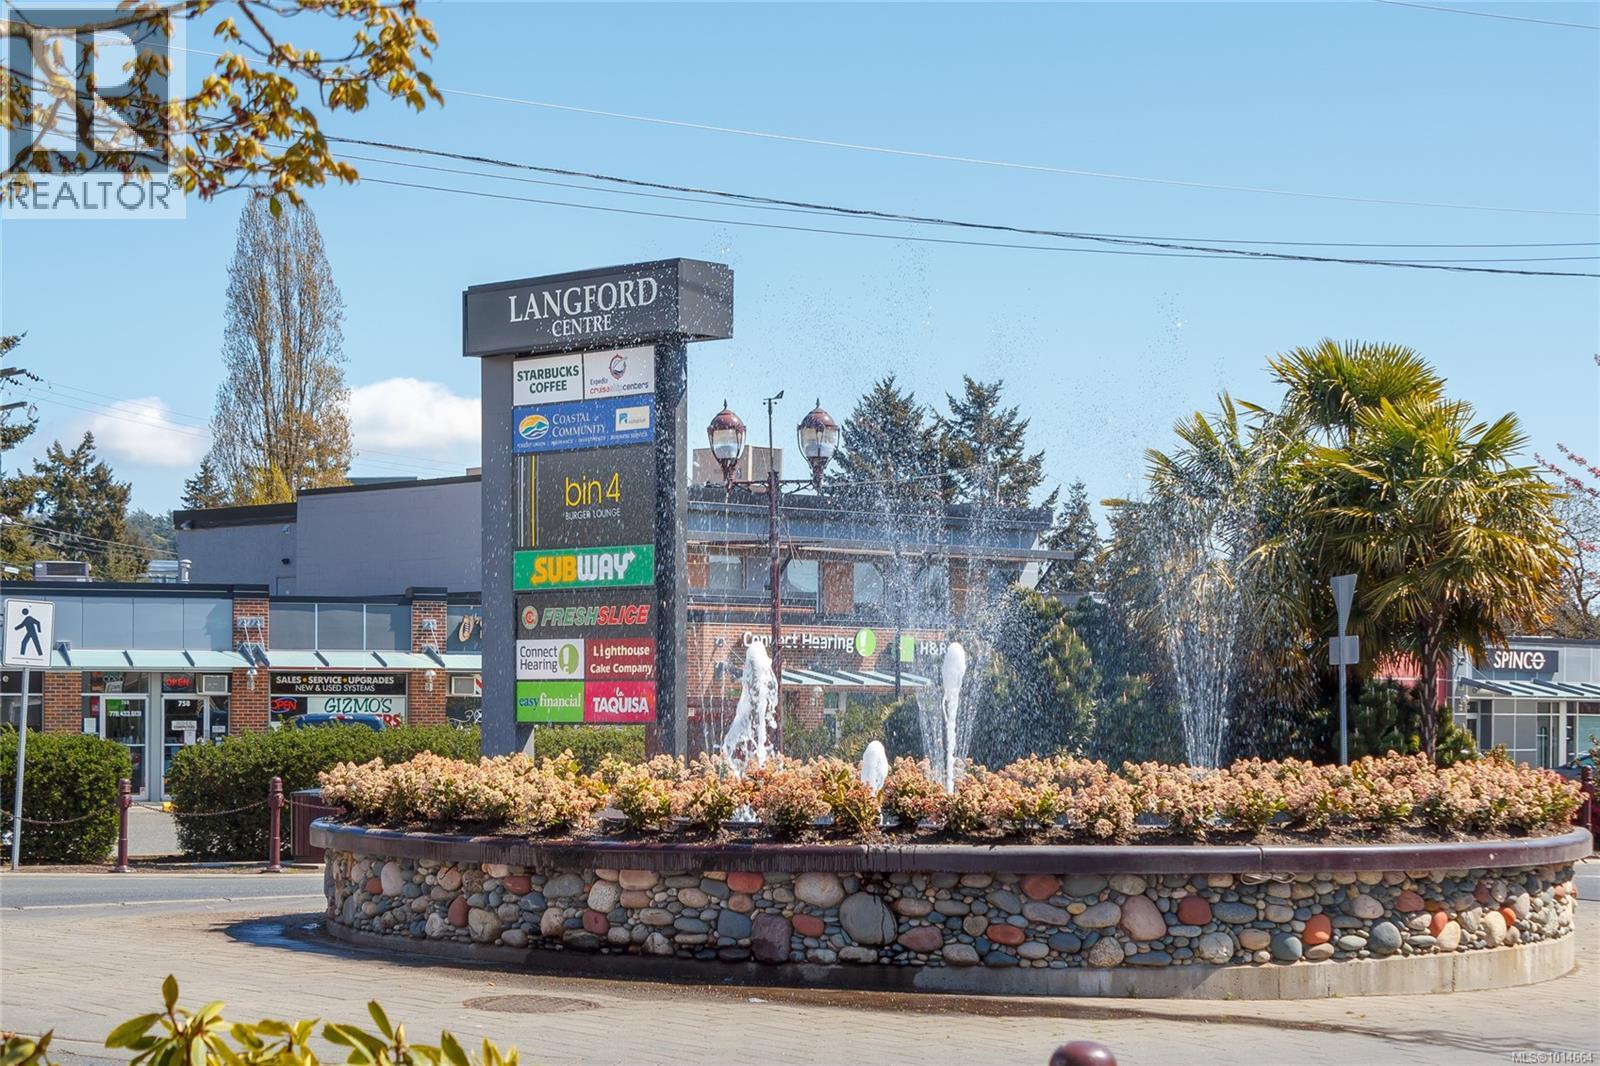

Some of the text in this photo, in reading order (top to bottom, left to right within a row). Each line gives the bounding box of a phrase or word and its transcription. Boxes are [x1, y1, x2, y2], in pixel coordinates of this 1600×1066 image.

[508, 277, 658, 322] LANGFORD
[552, 314, 612, 337] CENTRE
[517, 365, 579, 382] STARBUCKS
[529, 380, 567, 394] COFFEE
[564, 472, 621, 507] bin 4
[565, 508, 621, 520] BURGER LOUNGE
[530, 551, 635, 585] SUBWAY
[541, 604, 650, 627] FRESHSLICE
[802, 633, 854, 652] Hearing
[920, 641, 946, 656] H&R
[520, 646, 558, 658] Connect
[520, 659, 558, 673] Hearing
[1493, 650, 1546, 670] SPINCO
[590, 663, 653, 676] Cake Company
[165, 676, 190, 688] OPEN
[276, 676, 395, 685] SALES SERVICE UPGRADES
[295, 684, 376, 692] NEW & USED SYSTEMS
[271, 699, 297, 711] OPEN
[324, 697, 392, 713] GIZMO'S
[593, 697, 650, 714] TAQUISA
